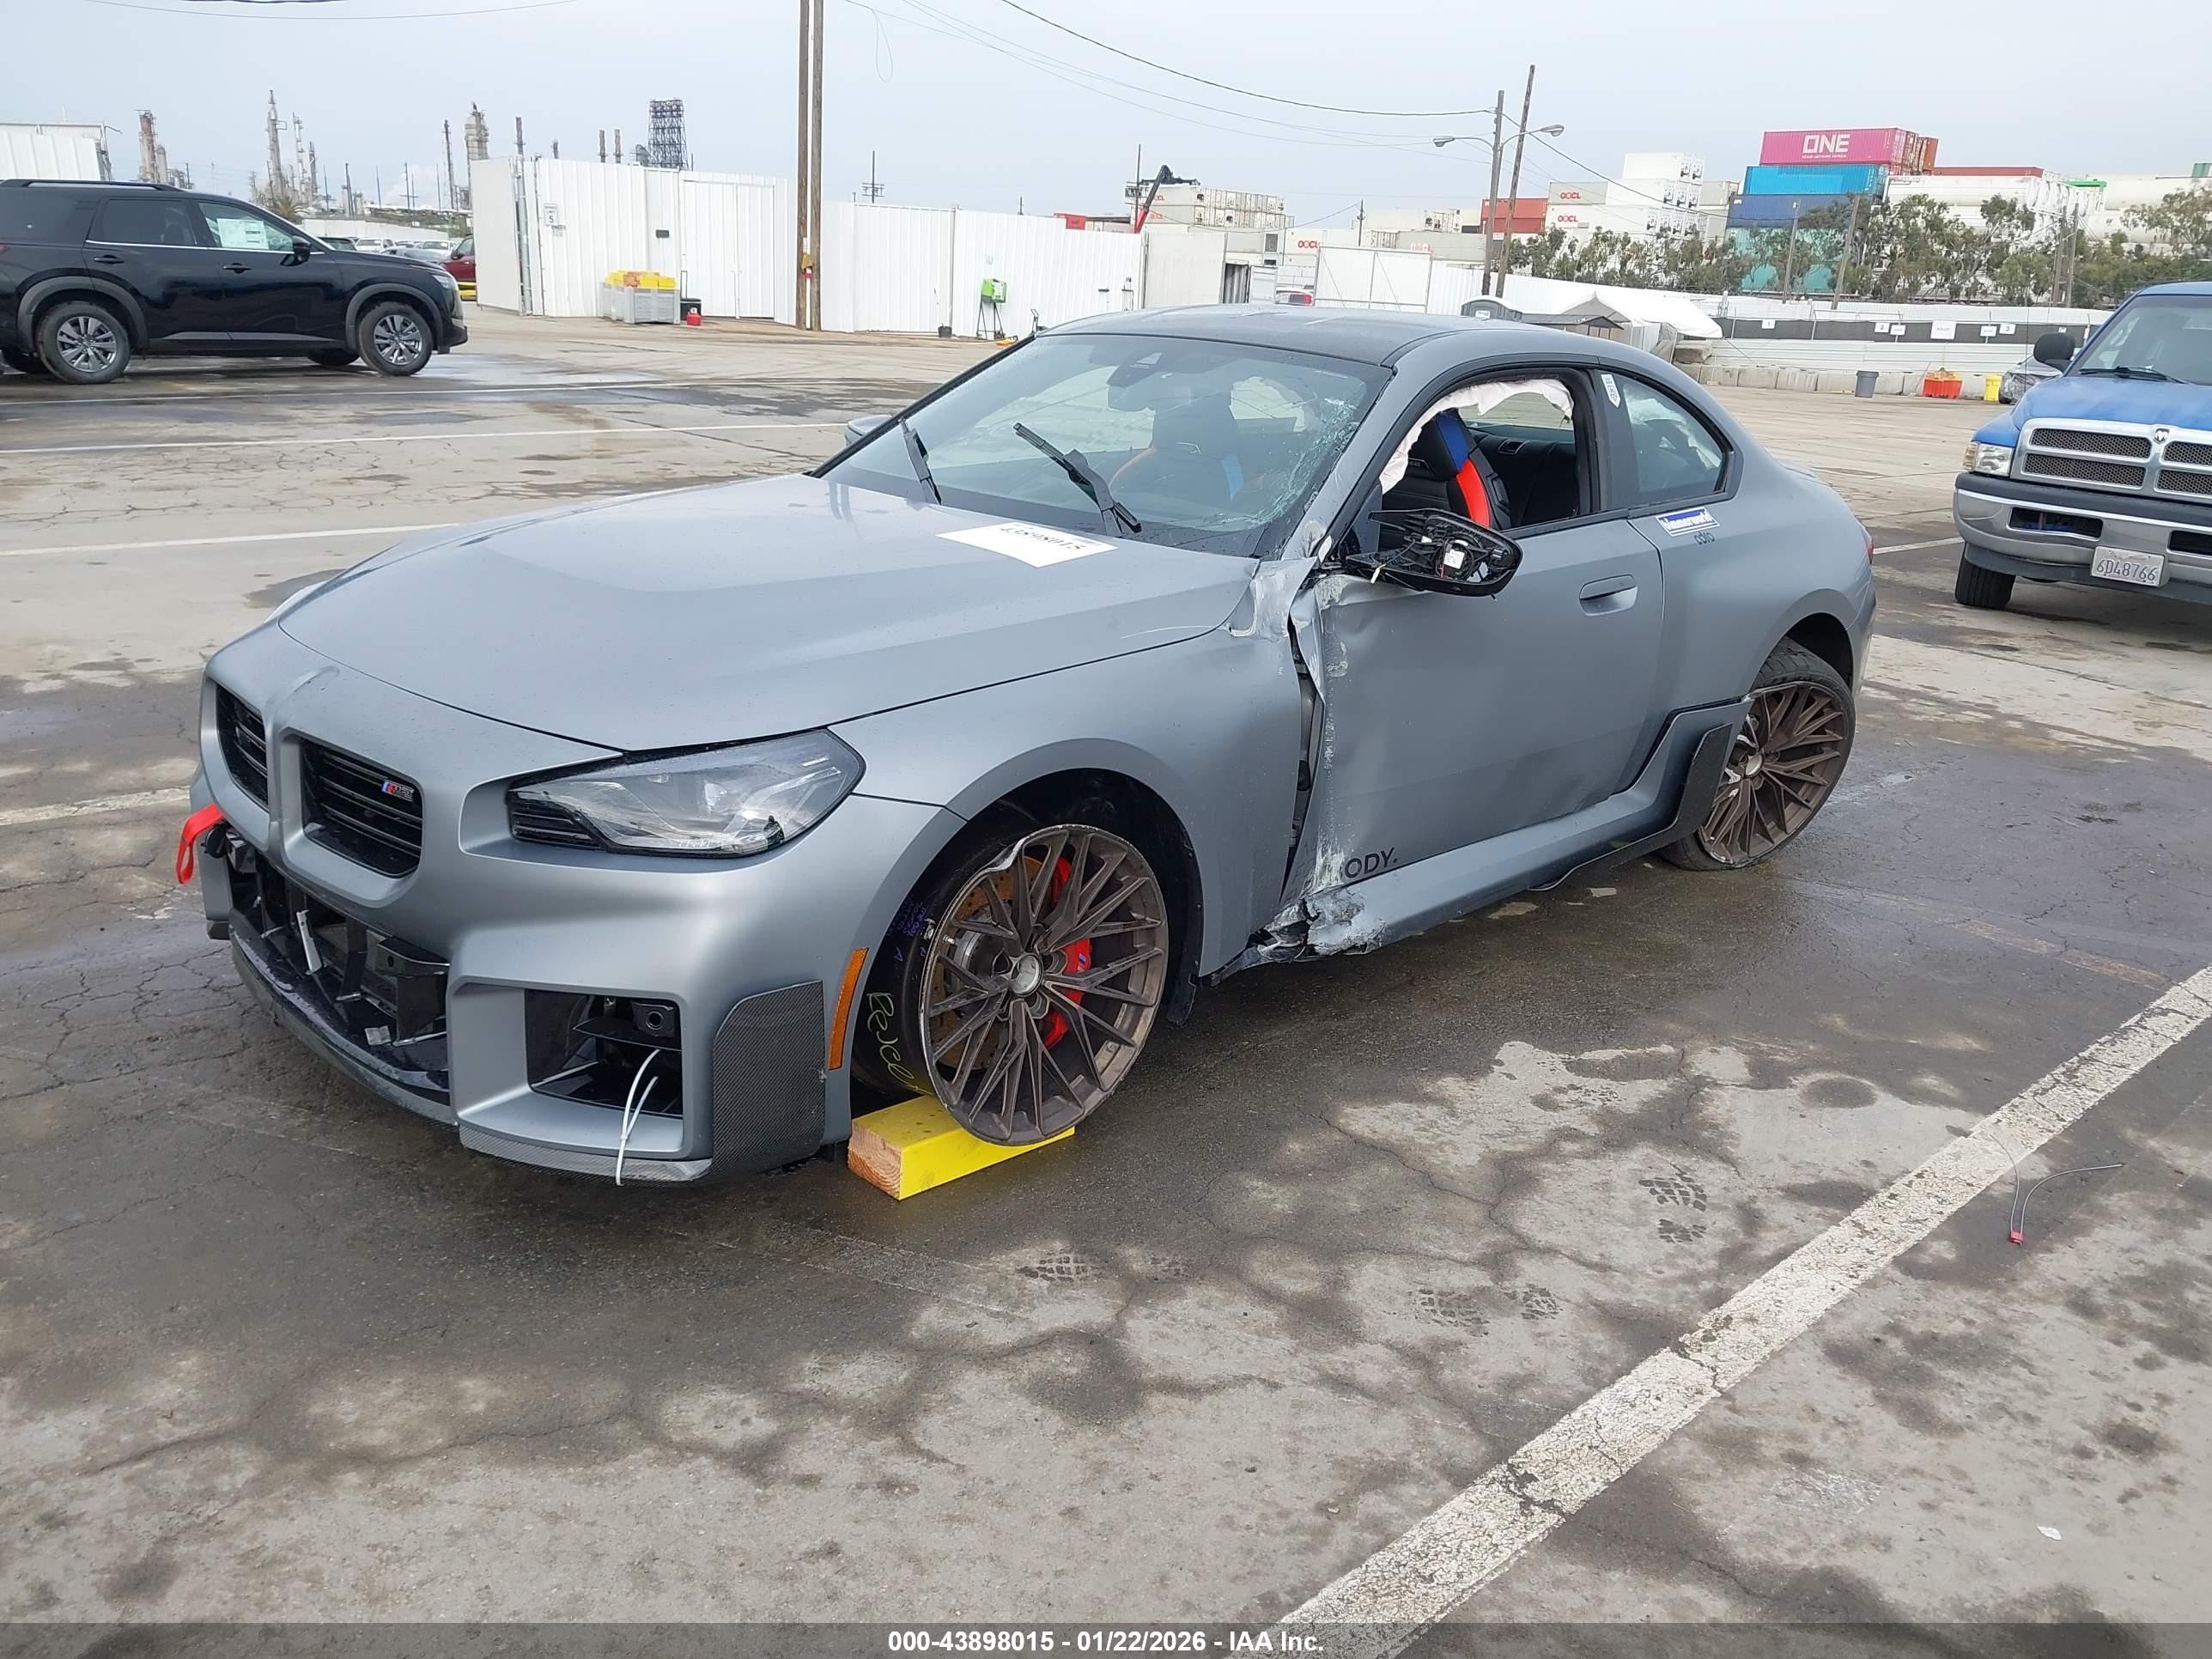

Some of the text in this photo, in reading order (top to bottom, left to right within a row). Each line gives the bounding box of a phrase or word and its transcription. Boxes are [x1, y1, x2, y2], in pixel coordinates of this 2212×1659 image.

[1802, 133, 1850, 153] ONE
[549, 215, 555, 223] 5
[2096, 559, 2158, 581] 6D48766
[1340, 847, 1398, 879] ODY.
